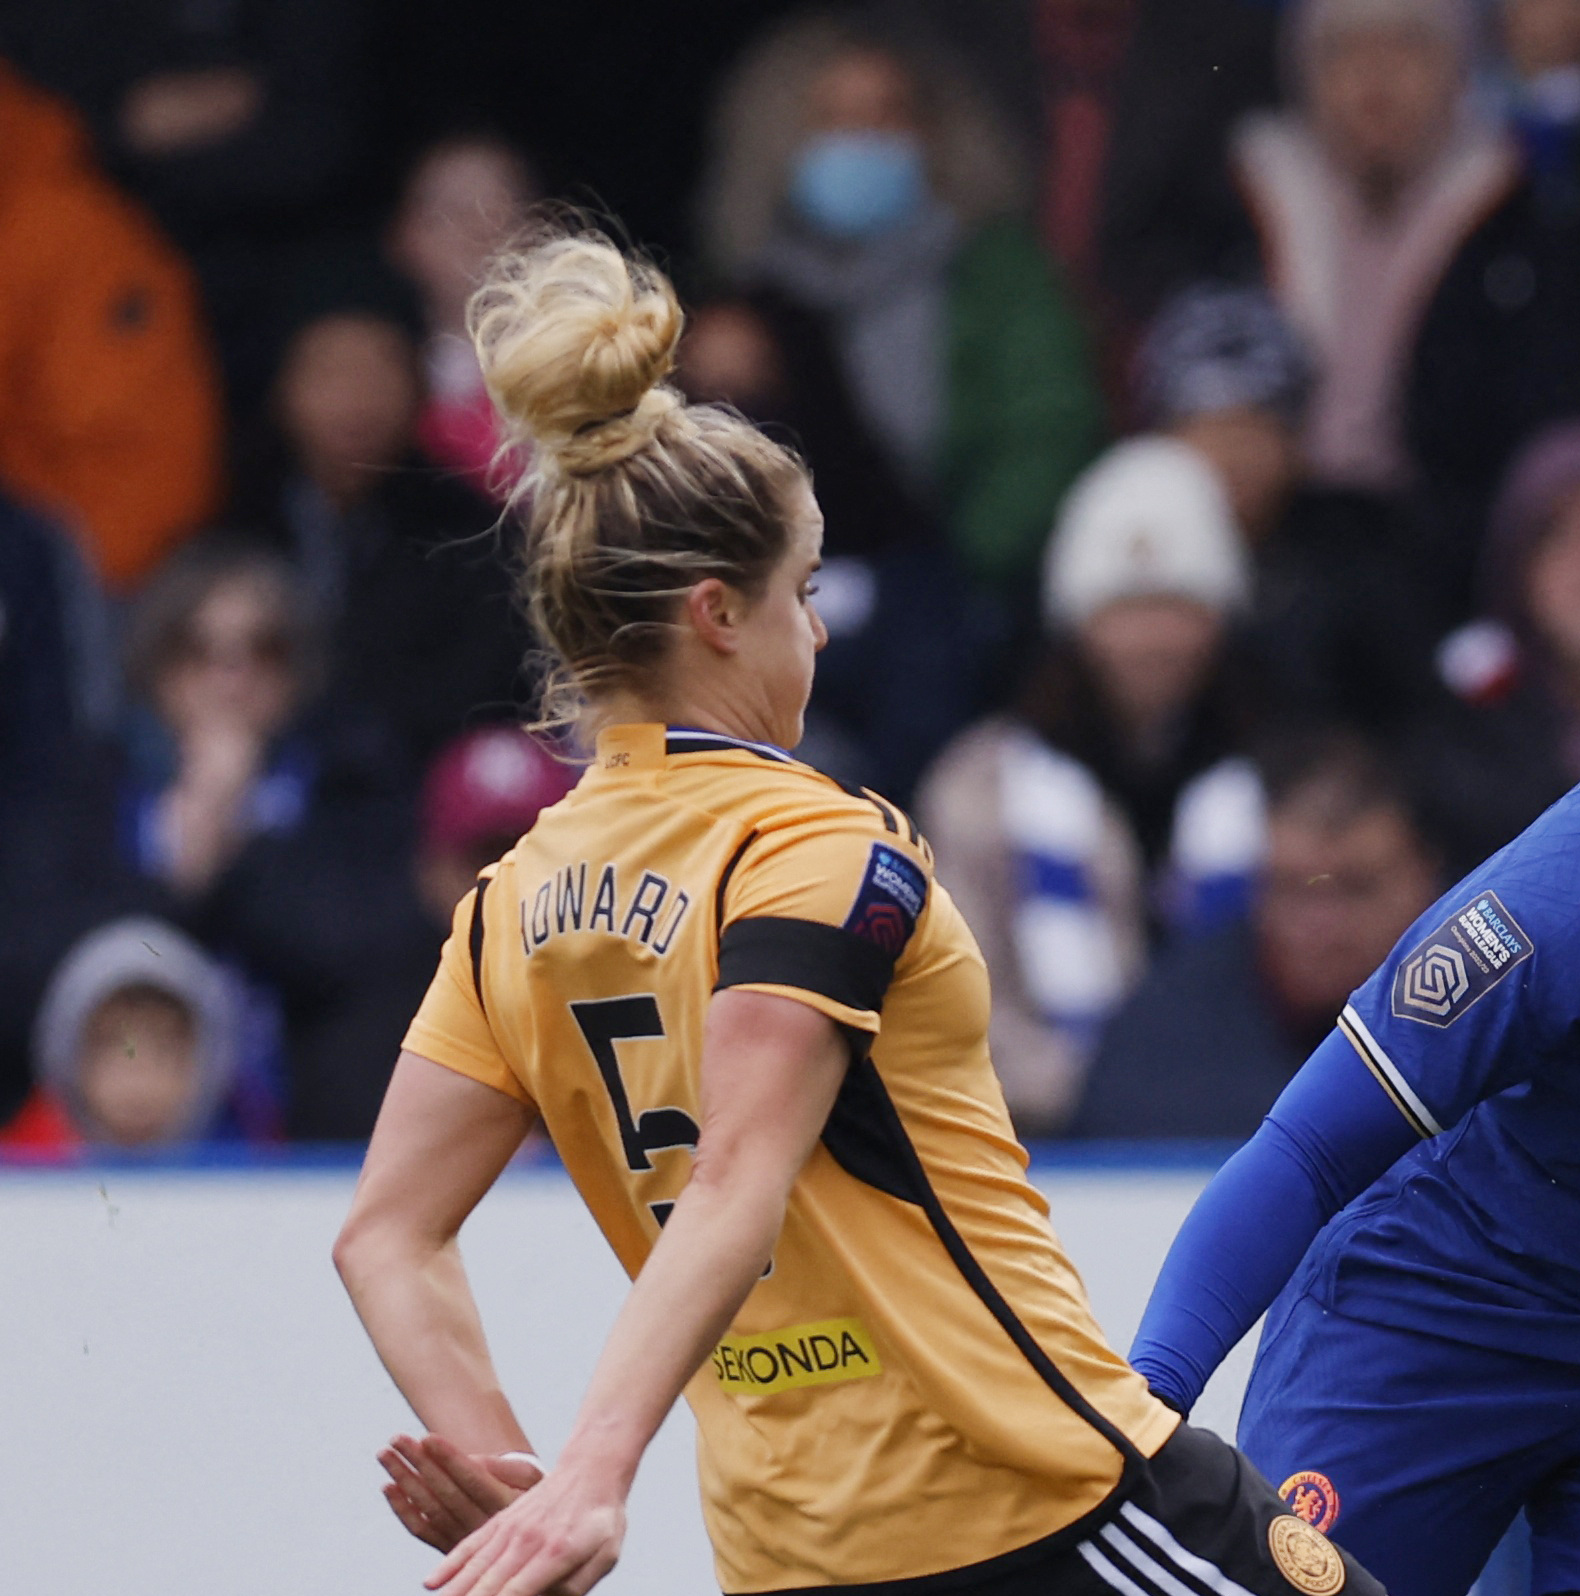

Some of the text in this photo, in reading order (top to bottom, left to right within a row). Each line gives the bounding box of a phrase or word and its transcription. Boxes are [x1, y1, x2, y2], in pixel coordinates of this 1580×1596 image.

[1458, 914, 1503, 970] SUPER LEAGUE
[1466, 906, 1511, 963] WOMEN'S
[1482, 906, 1522, 954] BARCLAYS
[711, 1330, 870, 1384] SEKONDA
